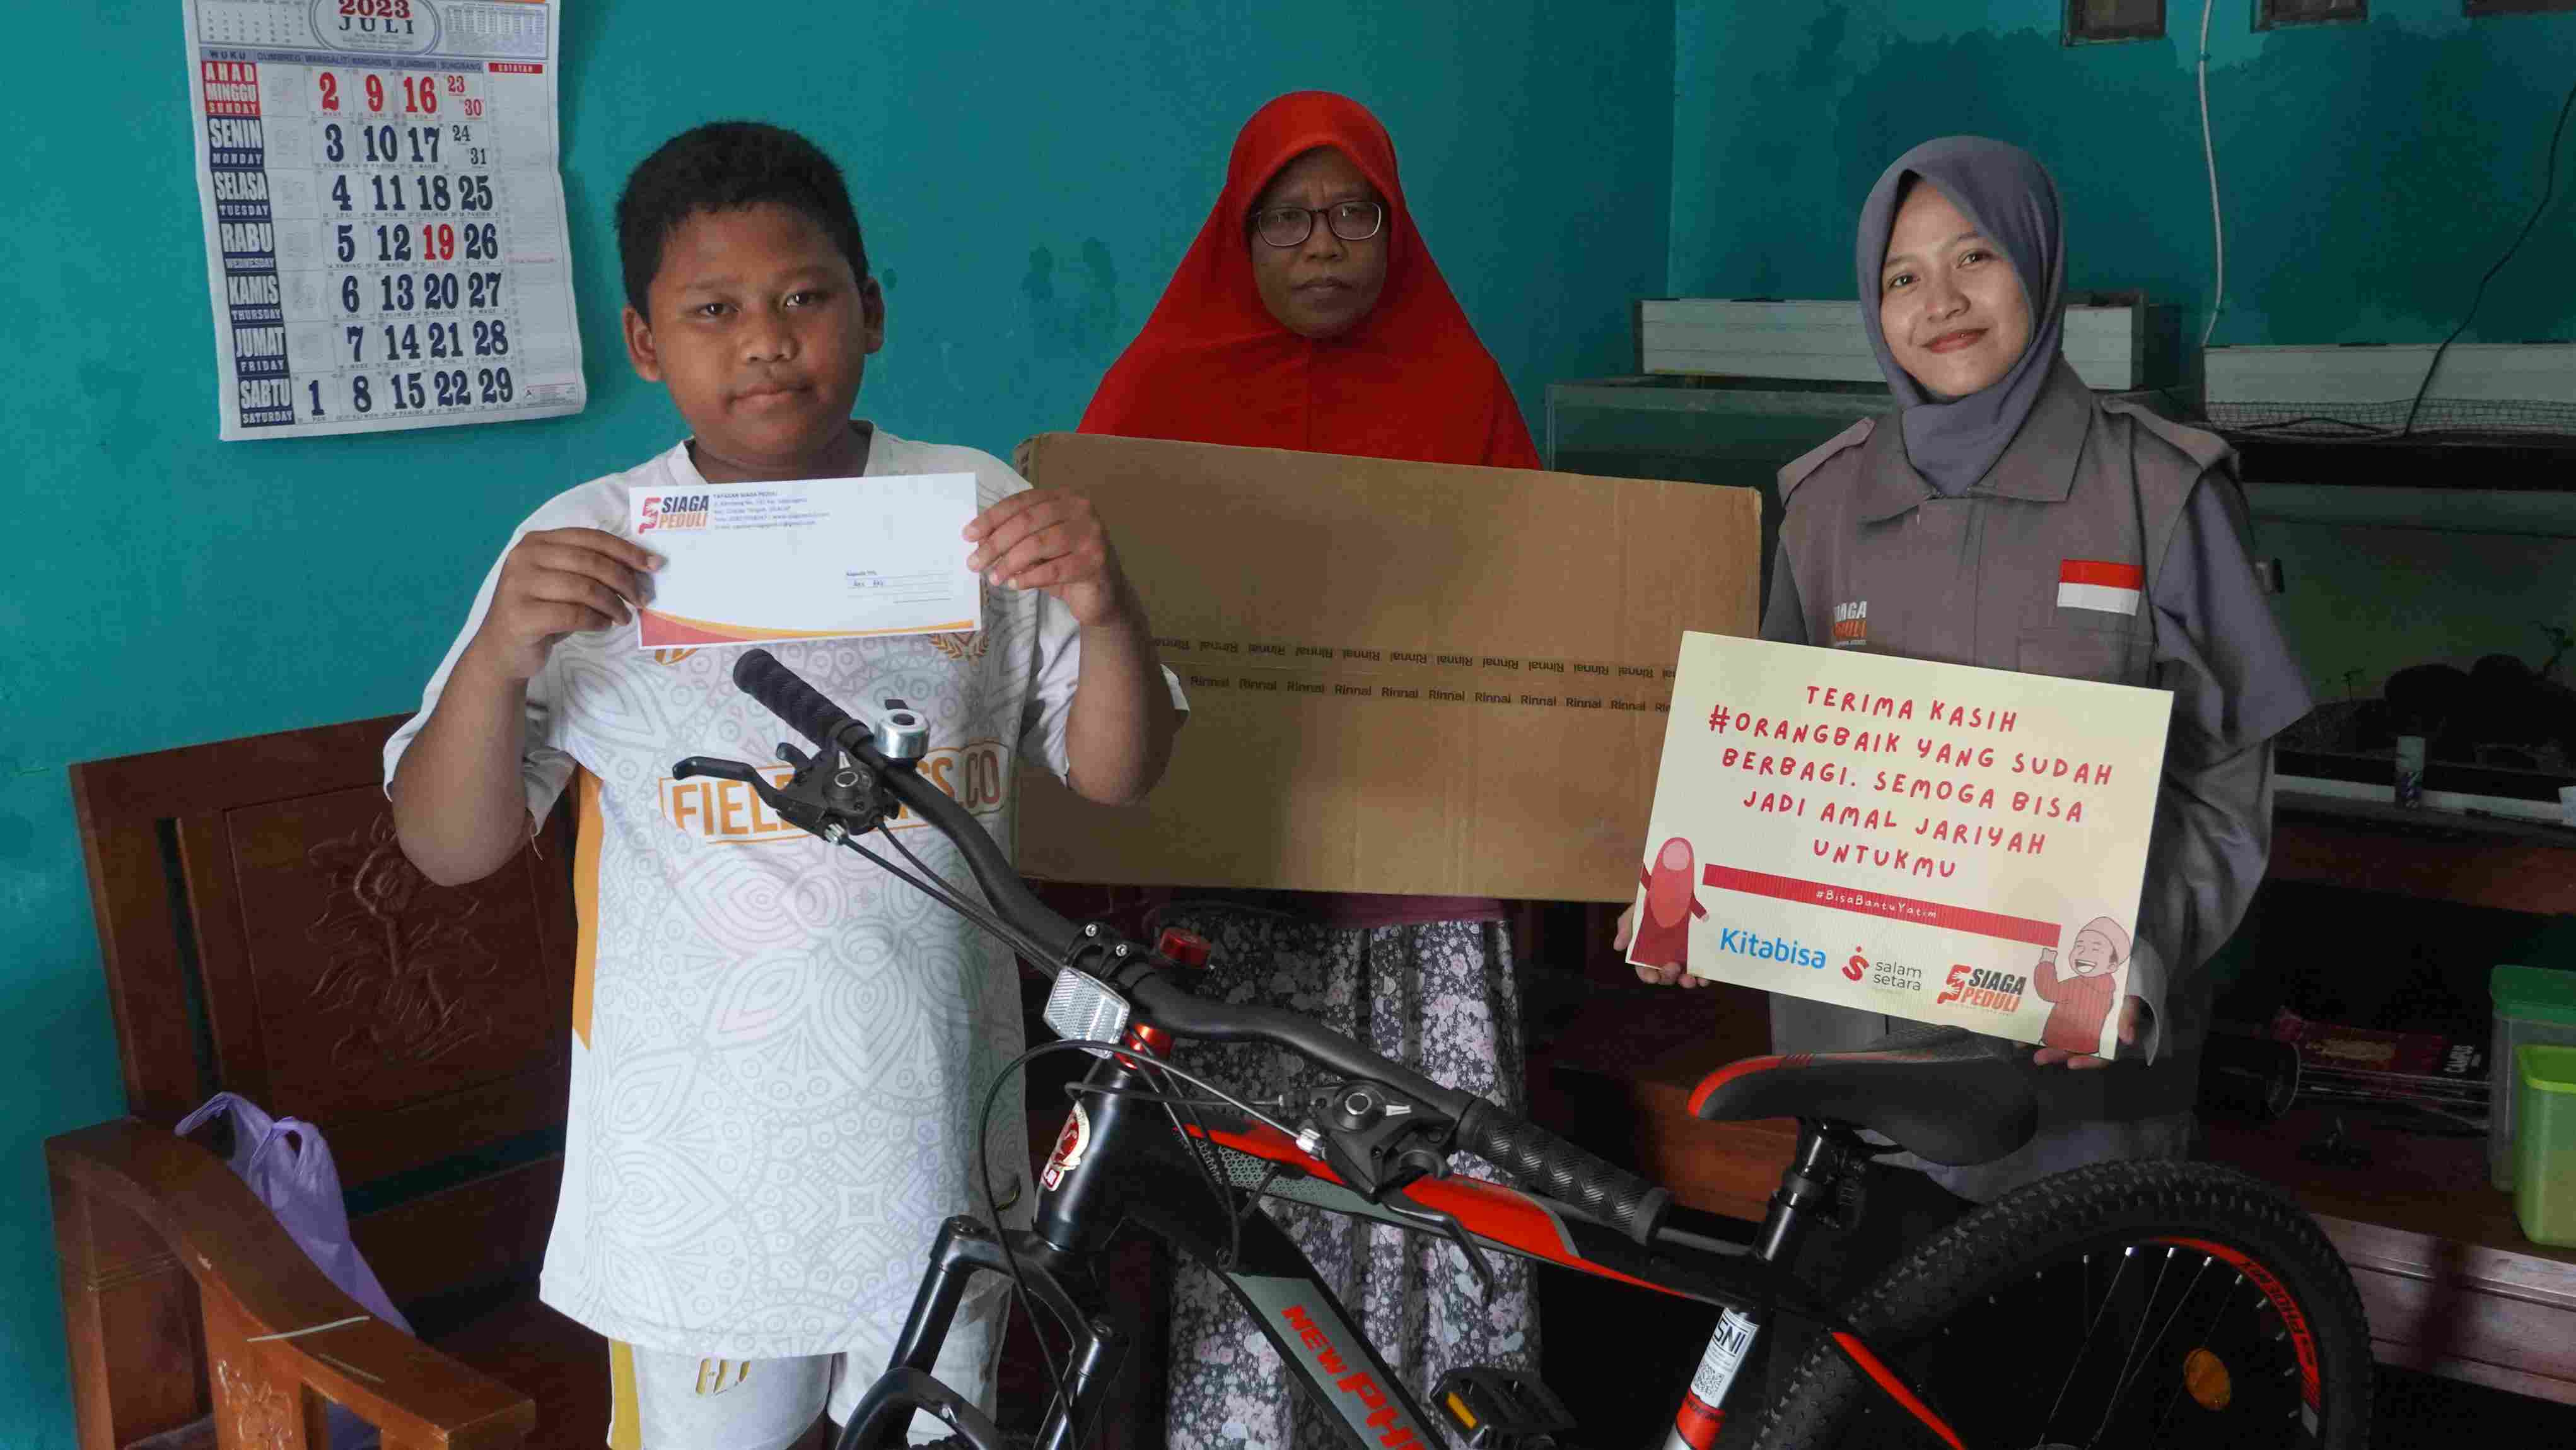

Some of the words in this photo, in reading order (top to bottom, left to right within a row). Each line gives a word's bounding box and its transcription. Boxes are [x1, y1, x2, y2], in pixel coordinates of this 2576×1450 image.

[339, 0, 411, 18] 2023
[339, 18, 414, 34] JULI
[209, 50, 246, 60] WUKU
[205, 64, 254, 81] AHAD
[206, 84, 257, 101] MINGGU
[320, 73, 339, 111] 2
[365, 74, 383, 112] 9
[404, 76, 437, 114] 16
[448, 76, 465, 93] 23
[209, 102, 257, 114] SUNDAY
[465, 99, 482, 116] 30
[209, 119, 263, 148] SENIN
[325, 124, 344, 162] 3
[364, 125, 398, 162] 10
[408, 126, 440, 163] 17
[453, 125, 470, 142] 24
[212, 153, 262, 164] MONDAY
[470, 147, 487, 165] 31
[213, 171, 268, 200] SELASA
[332, 175, 352, 211] 4
[372, 175, 405, 211] 11
[417, 175, 451, 211] 18
[458, 175, 492, 211] 25
[219, 205, 269, 216] TUESDAY
[221, 223, 274, 253] RABU
[337, 224, 355, 263] 5
[377, 224, 411, 261] 12
[423, 223, 455, 261] 19
[463, 223, 498, 260] 26
[225, 257, 275, 269] WEDNESDAY
[228, 275, 279, 305] KAMIS
[342, 275, 359, 313] 6
[381, 274, 414, 311] 13
[424, 272, 458, 310] 20
[468, 272, 501, 308] 27
[231, 309, 283, 320] THURSDAY
[234, 327, 284, 358] JUMAT
[346, 325, 364, 362] 7
[385, 324, 421, 361] 14
[428, 322, 463, 358] 21
[473, 319, 508, 356] 28
[240, 360, 284, 372] FRIDAY
[240, 379, 292, 409] SABTU
[308, 380, 325, 416] 1
[353, 375, 372, 412] 8
[391, 372, 426, 409] 15
[434, 370, 471, 407] 22
[478, 367, 513, 403] 29
[242, 411, 293, 424] SATURDAY
[661, 495, 709, 513] SIAGA
[658, 512, 708, 529] PEDULI
[1248, 641, 1286, 656] Rinnai
[1295, 645, 1333, 658] Rinnai
[1343, 648, 1380, 662] Rinnai
[1390, 650, 1427, 664] Rinnai
[1437, 655, 1473, 667] Rinnai
[1483, 657, 1518, 670] Rinnai
[1529, 660, 1564, 673] Rinnai
[1574, 664, 1609, 676] Rinnai
[1618, 667, 1654, 679] Rinnai
[1286, 681, 1326, 693] Rinnai
[1334, 684, 1372, 697] Rinnai
[1381, 686, 1419, 699] Rinnai
[1428, 689, 1465, 701] Rinnai
[1474, 692, 1511, 704] Rinnai
[1520, 694, 1556, 706] Rinnai
[1565, 697, 1602, 709] Rinnai
[1611, 699, 1645, 711] Rinnai
[1808, 686, 1913, 720] TERIMA
[1930, 701, 2017, 732] KASIH
[1710, 706, 1901, 752] #ORANGBAIK
[1917, 739, 1993, 768] YANG
[2013, 752, 2111, 783] SUDAH
[1722, 747, 1857, 788] BERBAGI.
[1874, 771, 1995, 808] SEMOGA
[2011, 793, 2083, 822] BISA
[1744, 790, 1805, 817] JADI
[1821, 802, 1897, 830] AMAL
[1916, 818, 2046, 855] JARIYAH
[1812, 839, 1956, 879] UNTUKMU
[1815, 889, 1937, 919] #BisaBantuYatim
[1720, 927, 1826, 969] Kitabisa
[1875, 960, 1923, 979] salam
[1872, 974, 1922, 991] setara
[1968, 968, 2027, 996] SIAGA
[1961, 988, 2021, 1014] PEDULI
[1281, 1304, 1348, 1376] NEW
[1713, 1317, 1747, 1355] SNI
